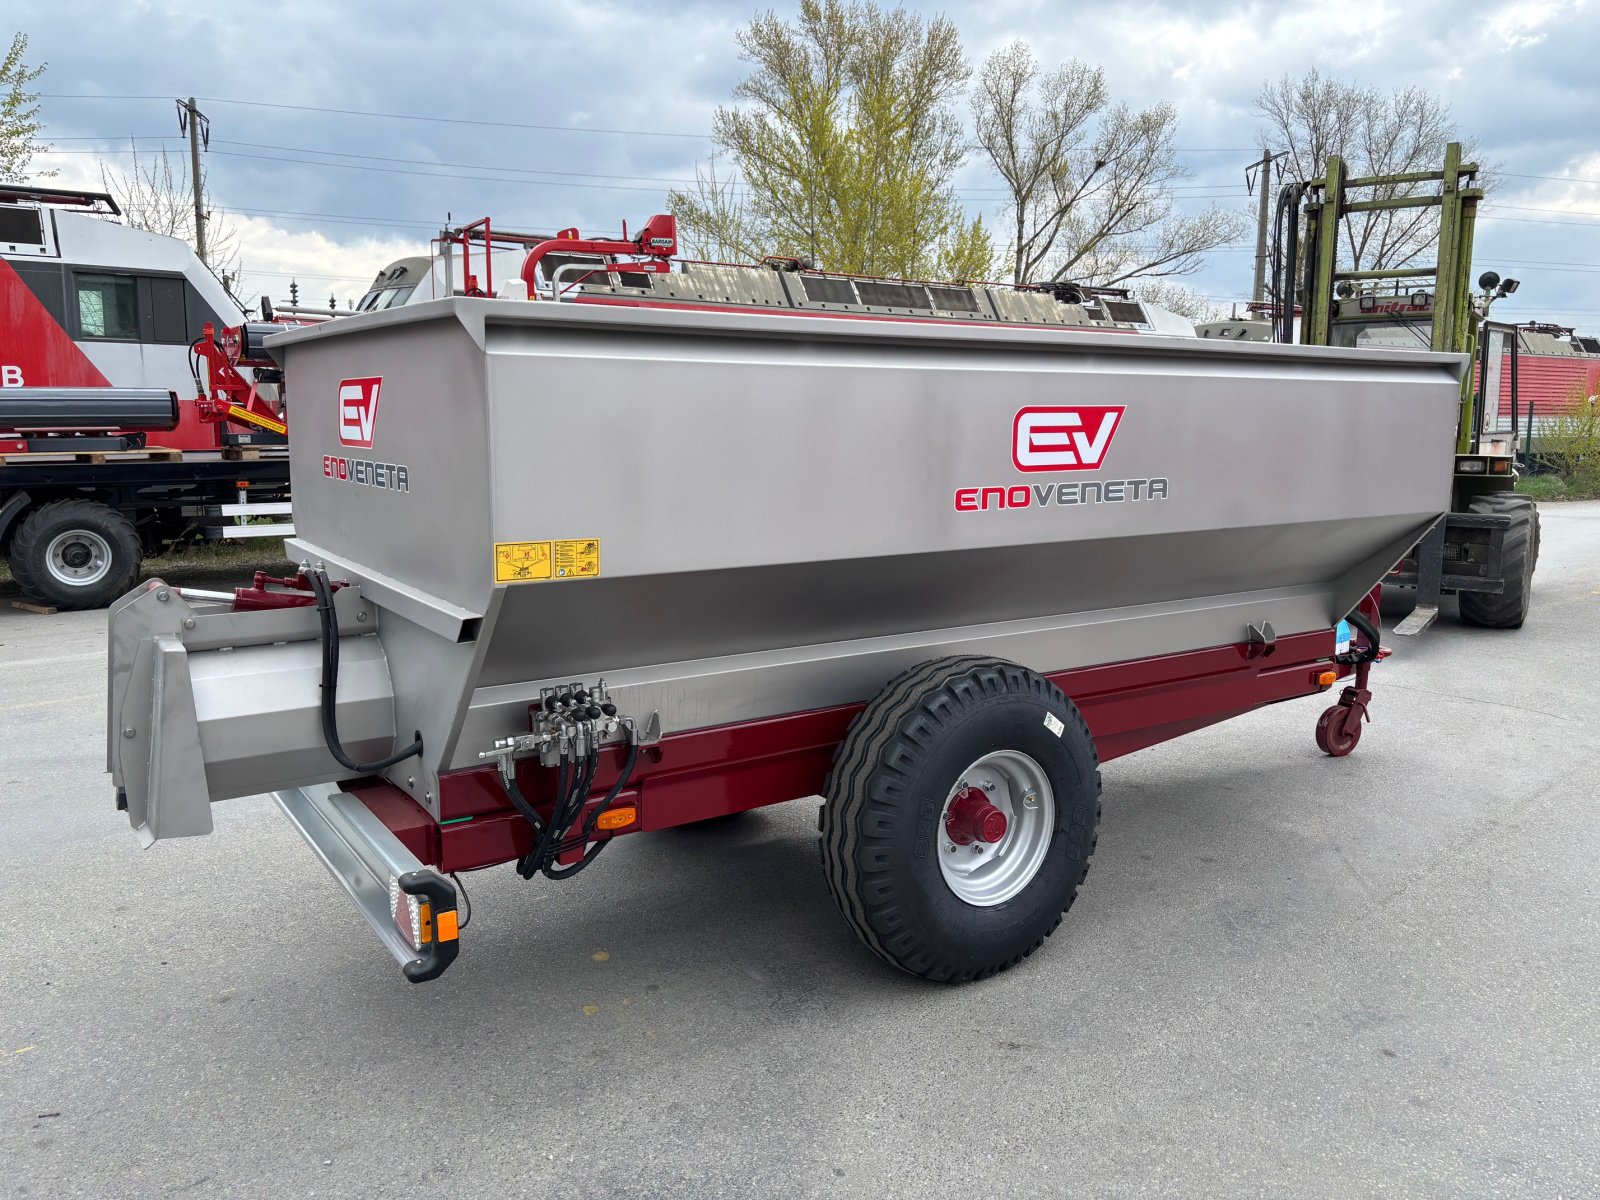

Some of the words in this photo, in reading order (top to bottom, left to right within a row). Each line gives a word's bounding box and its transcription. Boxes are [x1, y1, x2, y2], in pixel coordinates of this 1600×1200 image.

[2, 365, 25, 388] B
[340, 384, 379, 441] EV
[1016, 411, 1119, 466] EV
